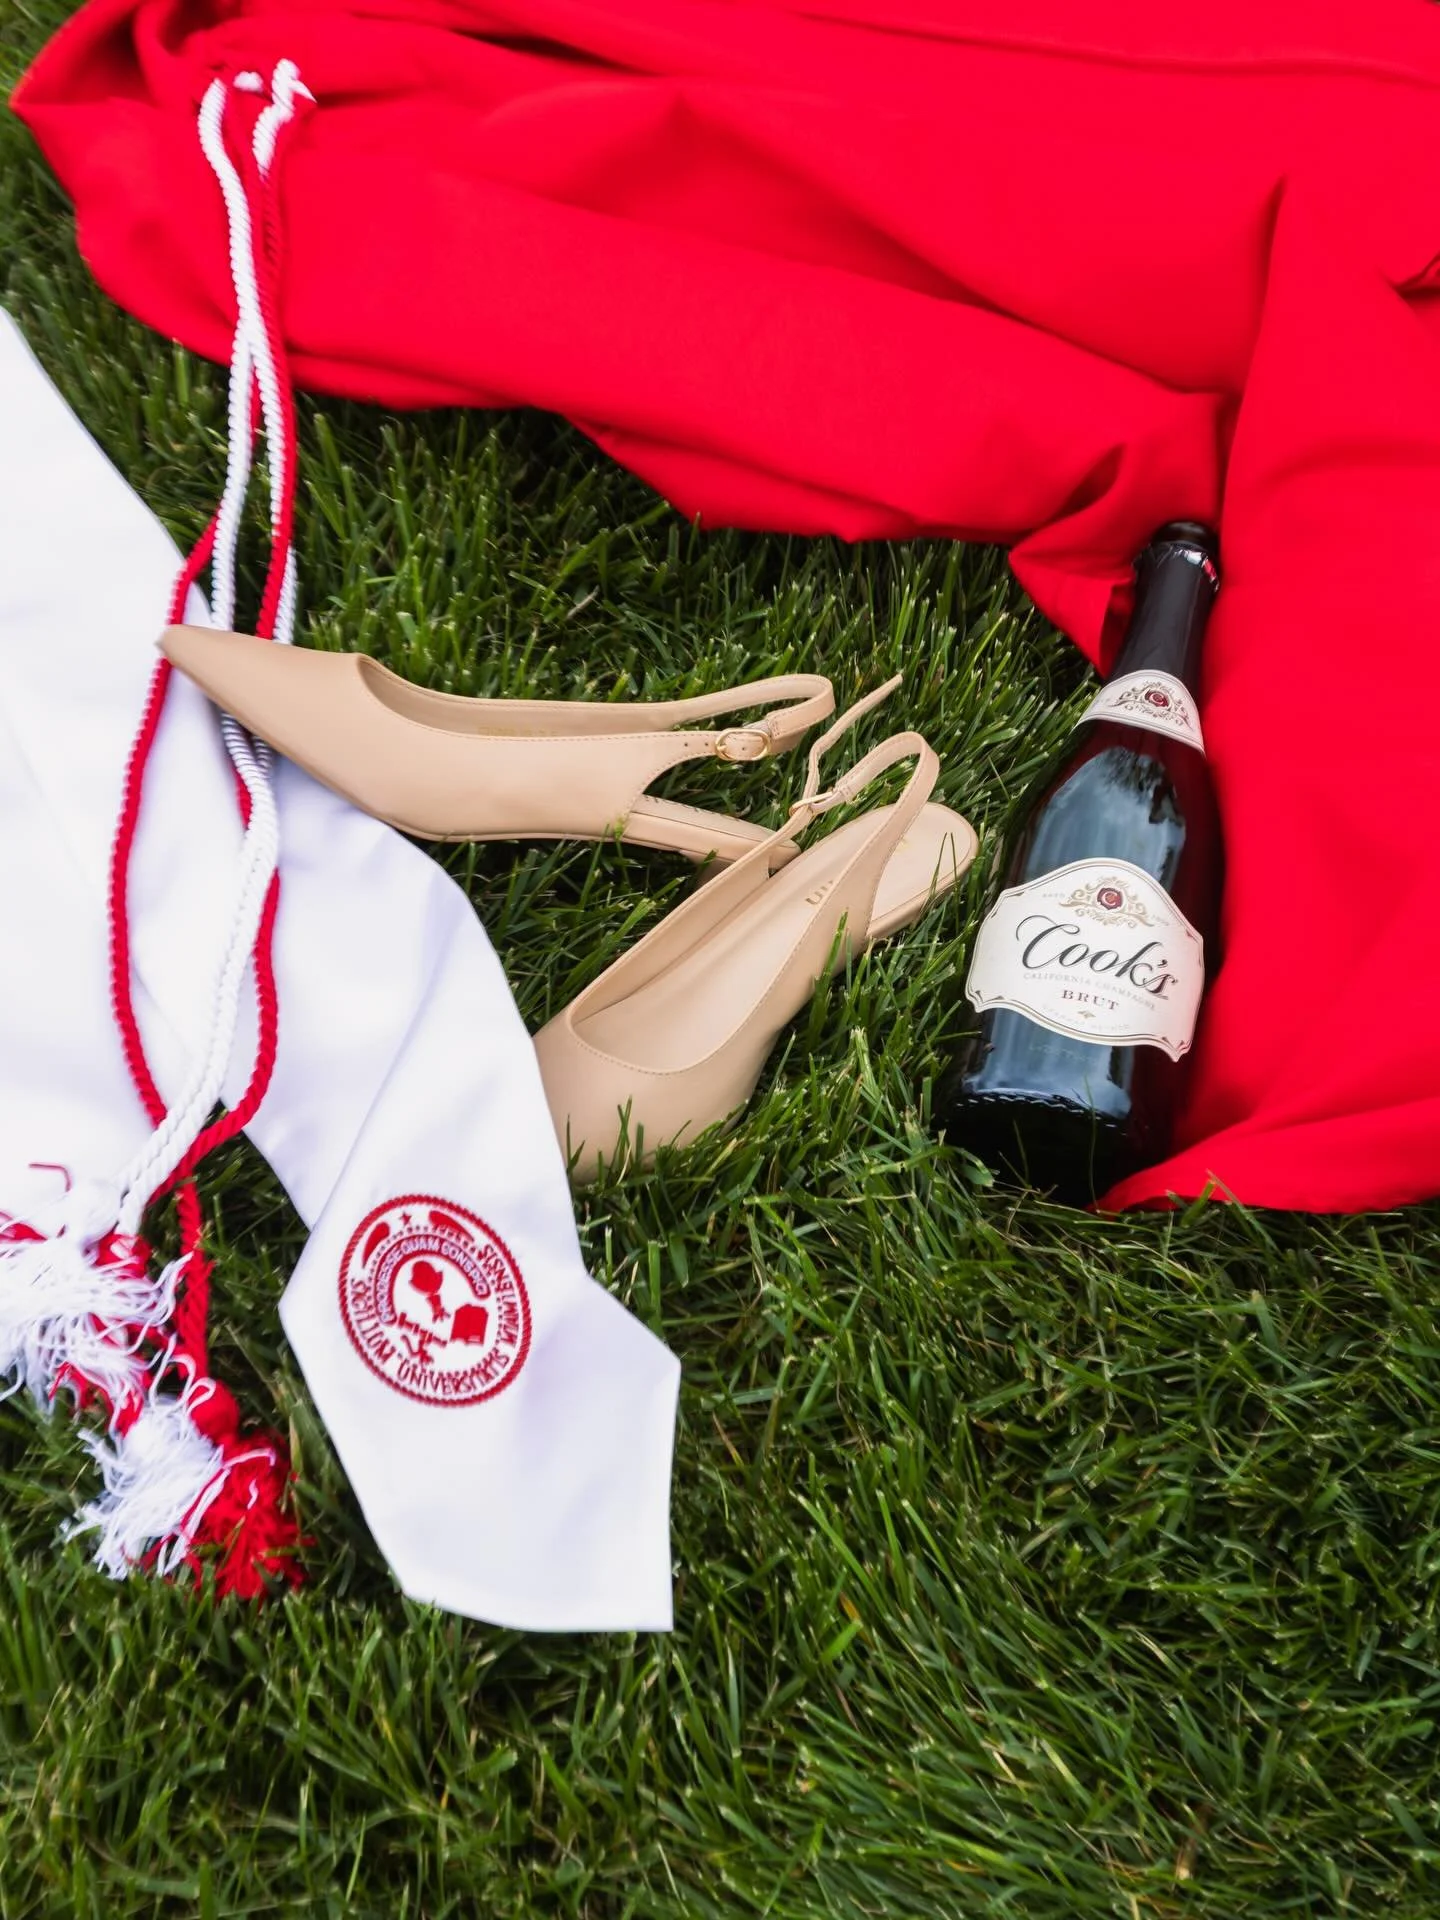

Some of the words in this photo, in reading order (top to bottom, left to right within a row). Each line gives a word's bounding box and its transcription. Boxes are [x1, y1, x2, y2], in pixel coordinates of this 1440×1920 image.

[1015, 914, 1178, 1000] Cook's
[1022, 971, 1092, 987] CALIFORNIA
[1060, 989, 1120, 1011] BRUT
[401, 1237, 441, 1256] QUAM
